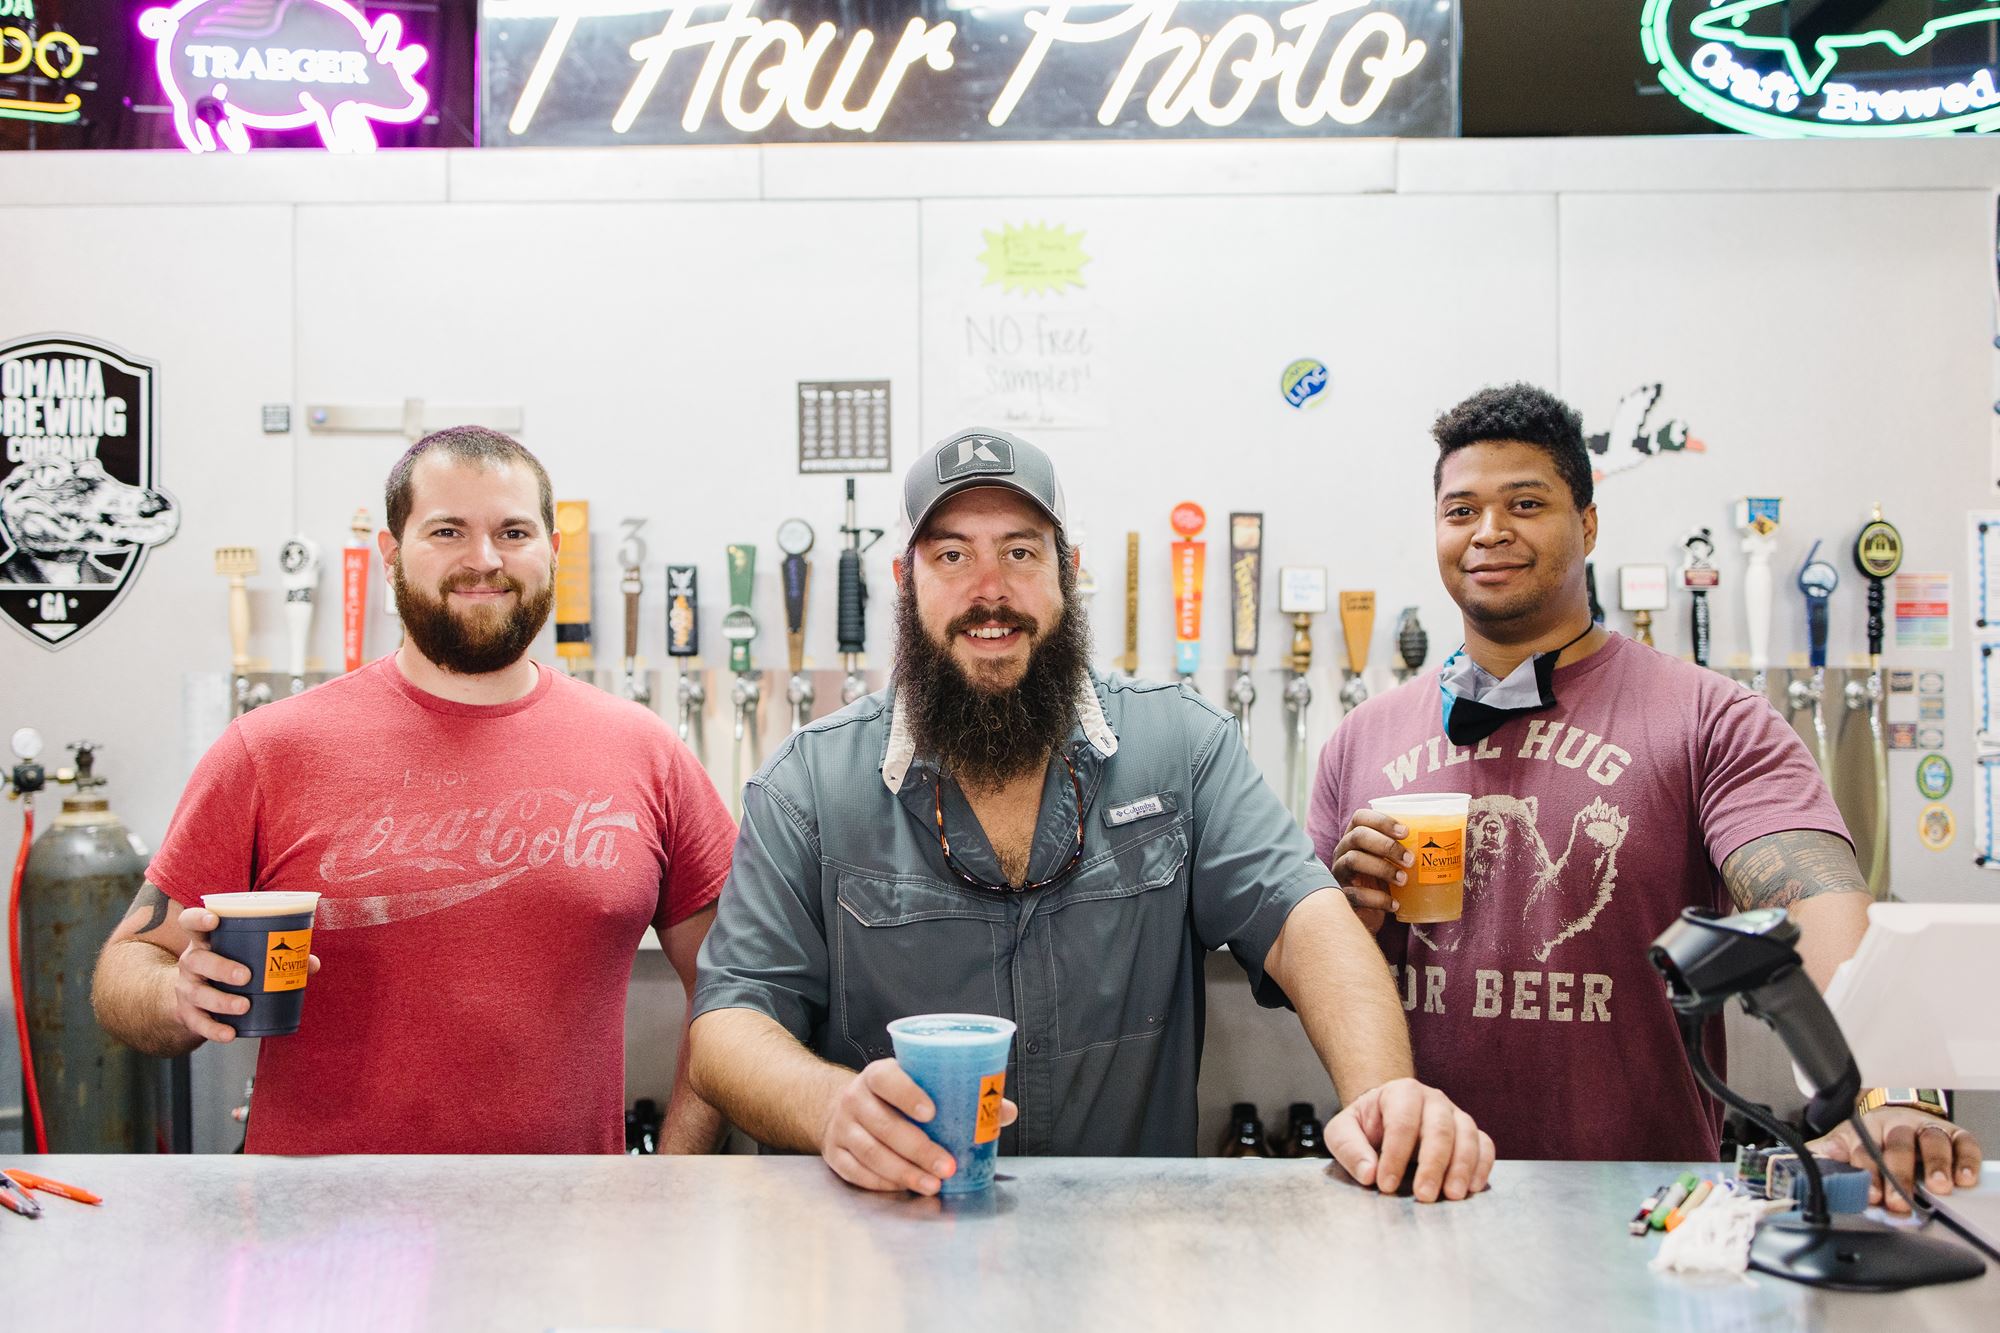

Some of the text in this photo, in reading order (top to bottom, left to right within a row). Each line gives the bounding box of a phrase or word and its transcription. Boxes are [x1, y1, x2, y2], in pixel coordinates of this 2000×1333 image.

[185, 45, 370, 84] TRAEGER
[611, 0, 957, 133] Hour
[988, 0, 1427, 127] Photo
[1691, 42, 2000, 122] Craft Brewed
[966, 313, 1025, 356] NO
[2, 358, 106, 398] OMAHA
[0, 396, 127, 436] REWING
[6, 435, 100, 463] COMPANY
[40, 592, 67, 621] GA
[1518, 720, 1633, 786] HUG
[1123, 802, 1156, 815] Columbia
[1388, 964, 1447, 1014] OR
[1472, 969, 1614, 1022] BEER
